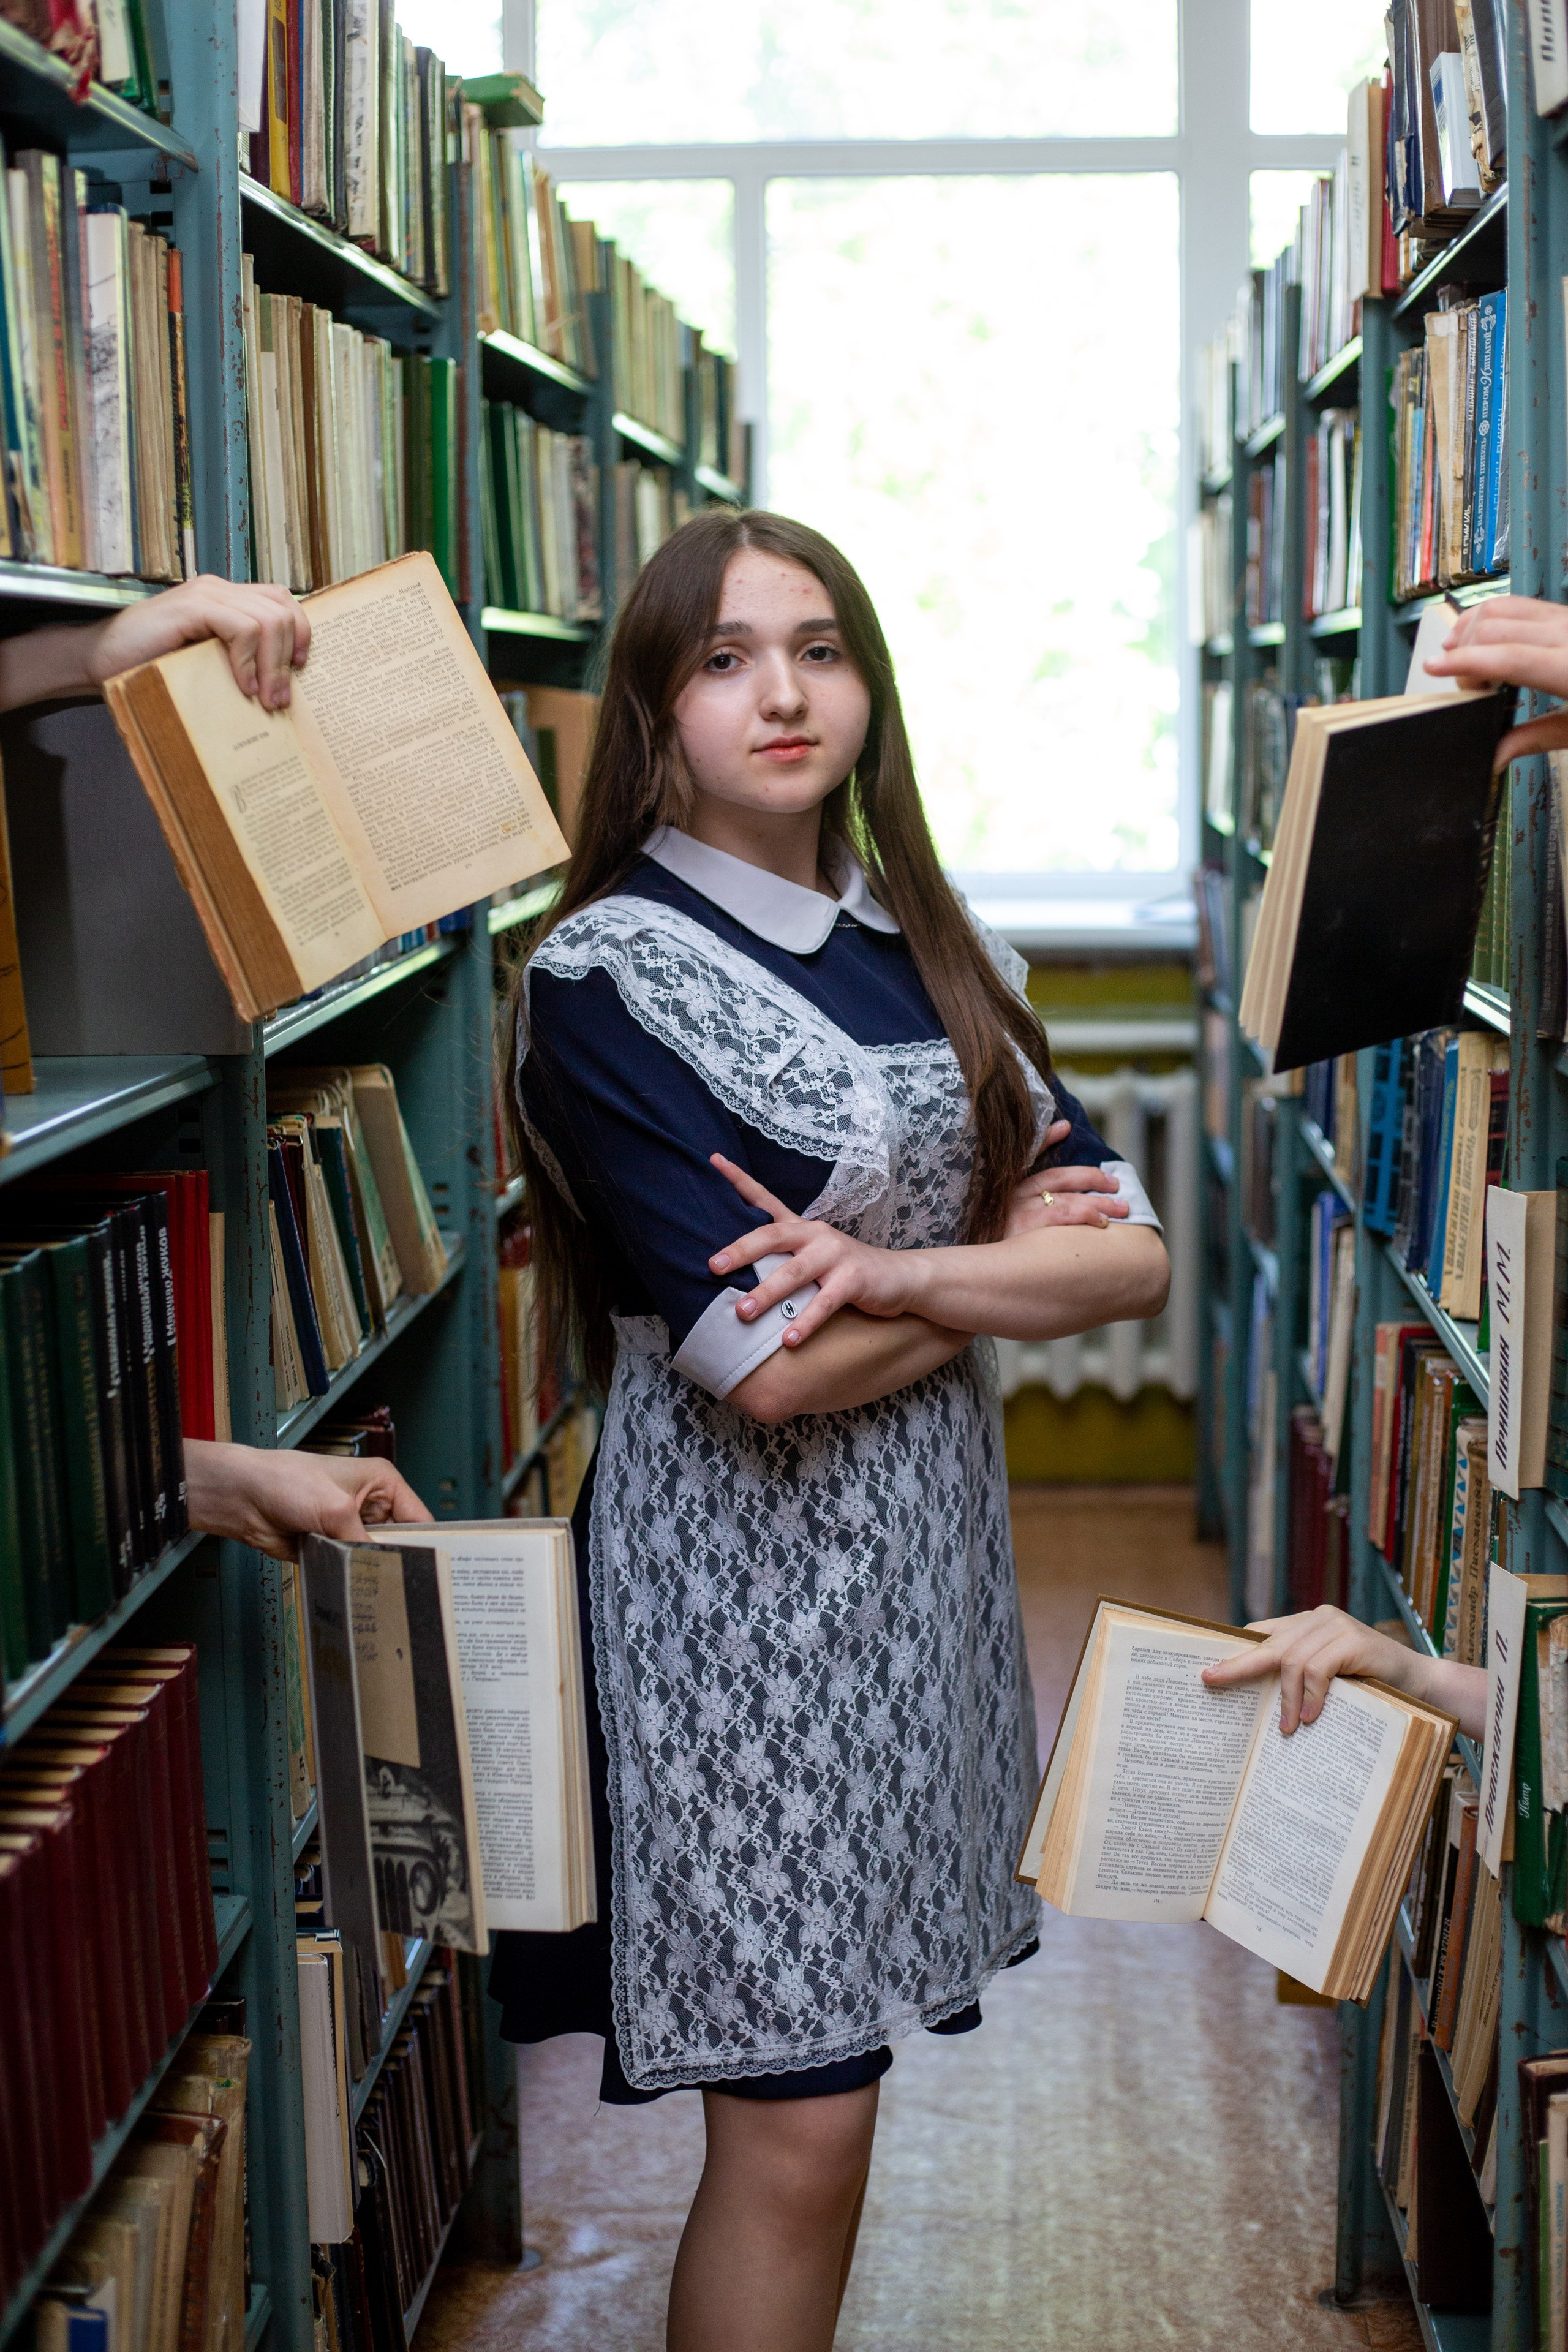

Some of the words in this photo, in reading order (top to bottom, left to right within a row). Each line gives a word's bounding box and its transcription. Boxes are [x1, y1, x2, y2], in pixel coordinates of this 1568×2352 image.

[1483, 331, 1492, 370] ШПАГОЙ
[1457, 1194, 1471, 1272] ВАЛЕНТИН
[1468, 1477, 1482, 1580] Письменный
[1485, 1675, 1505, 1834] Проскурин
[1495, 1630, 1509, 1664] П.
[1518, 1781, 1531, 1819] Петр
